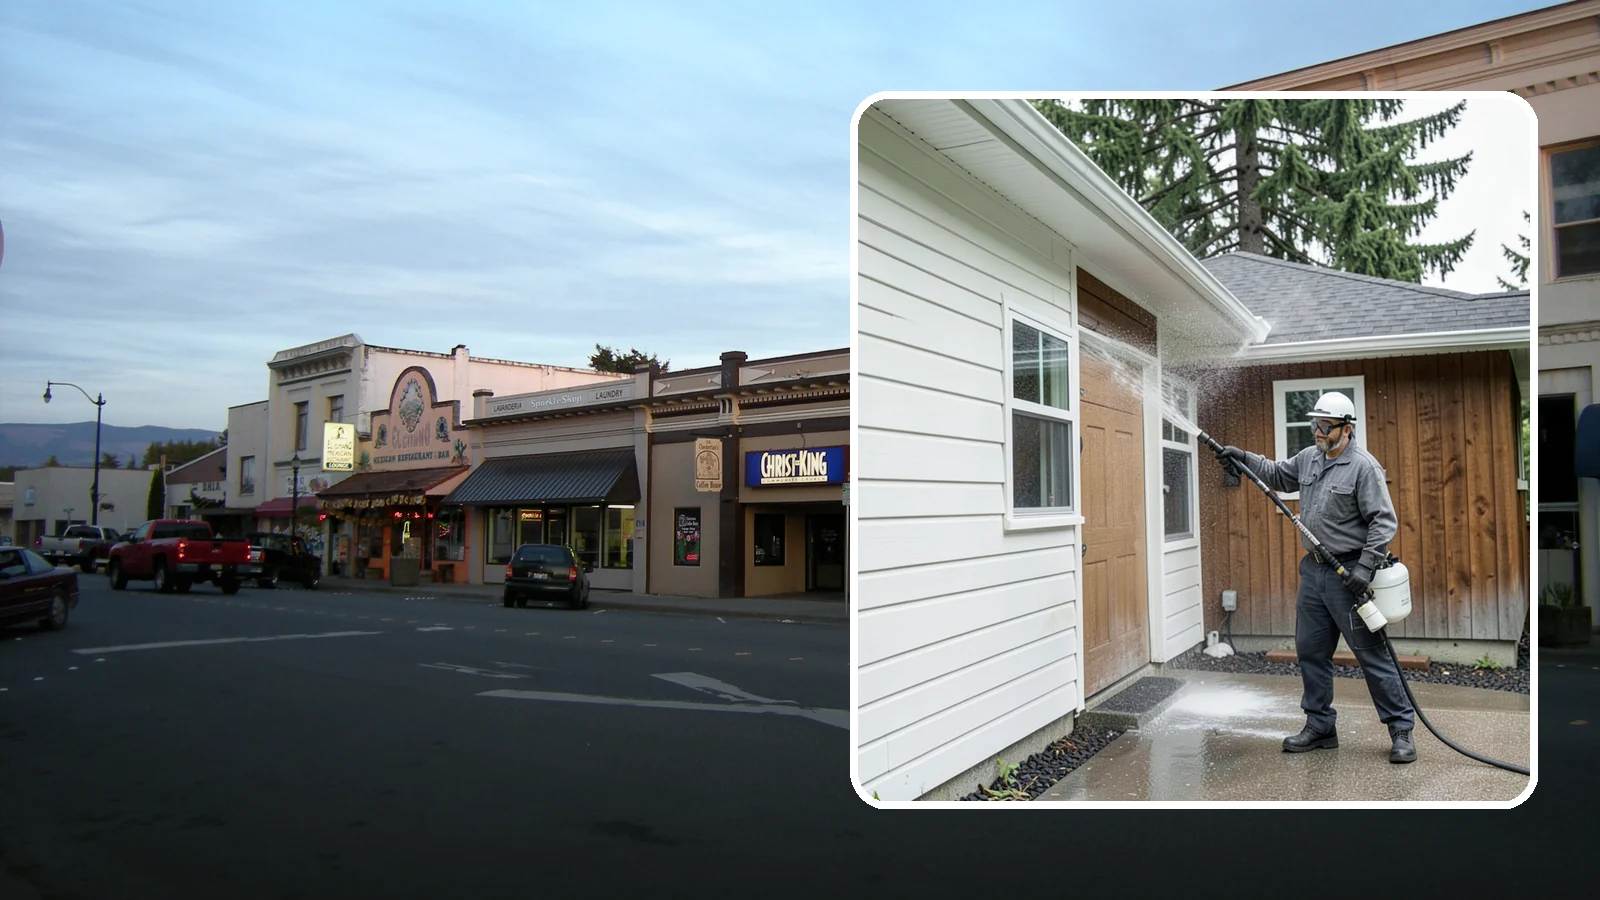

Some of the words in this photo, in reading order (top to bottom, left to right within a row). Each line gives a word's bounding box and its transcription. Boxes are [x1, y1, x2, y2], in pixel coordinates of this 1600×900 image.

[493, 402, 522, 412] LAVANDERIA
[531, 396, 561, 409] Sparkle
[562, 394, 582, 404] Shop
[595, 389, 623, 400] LAUNDRY
[373, 455, 396, 465] MEXICAN
[397, 451, 433, 462] RESTAURANT
[437, 450, 450, 459] BAR
